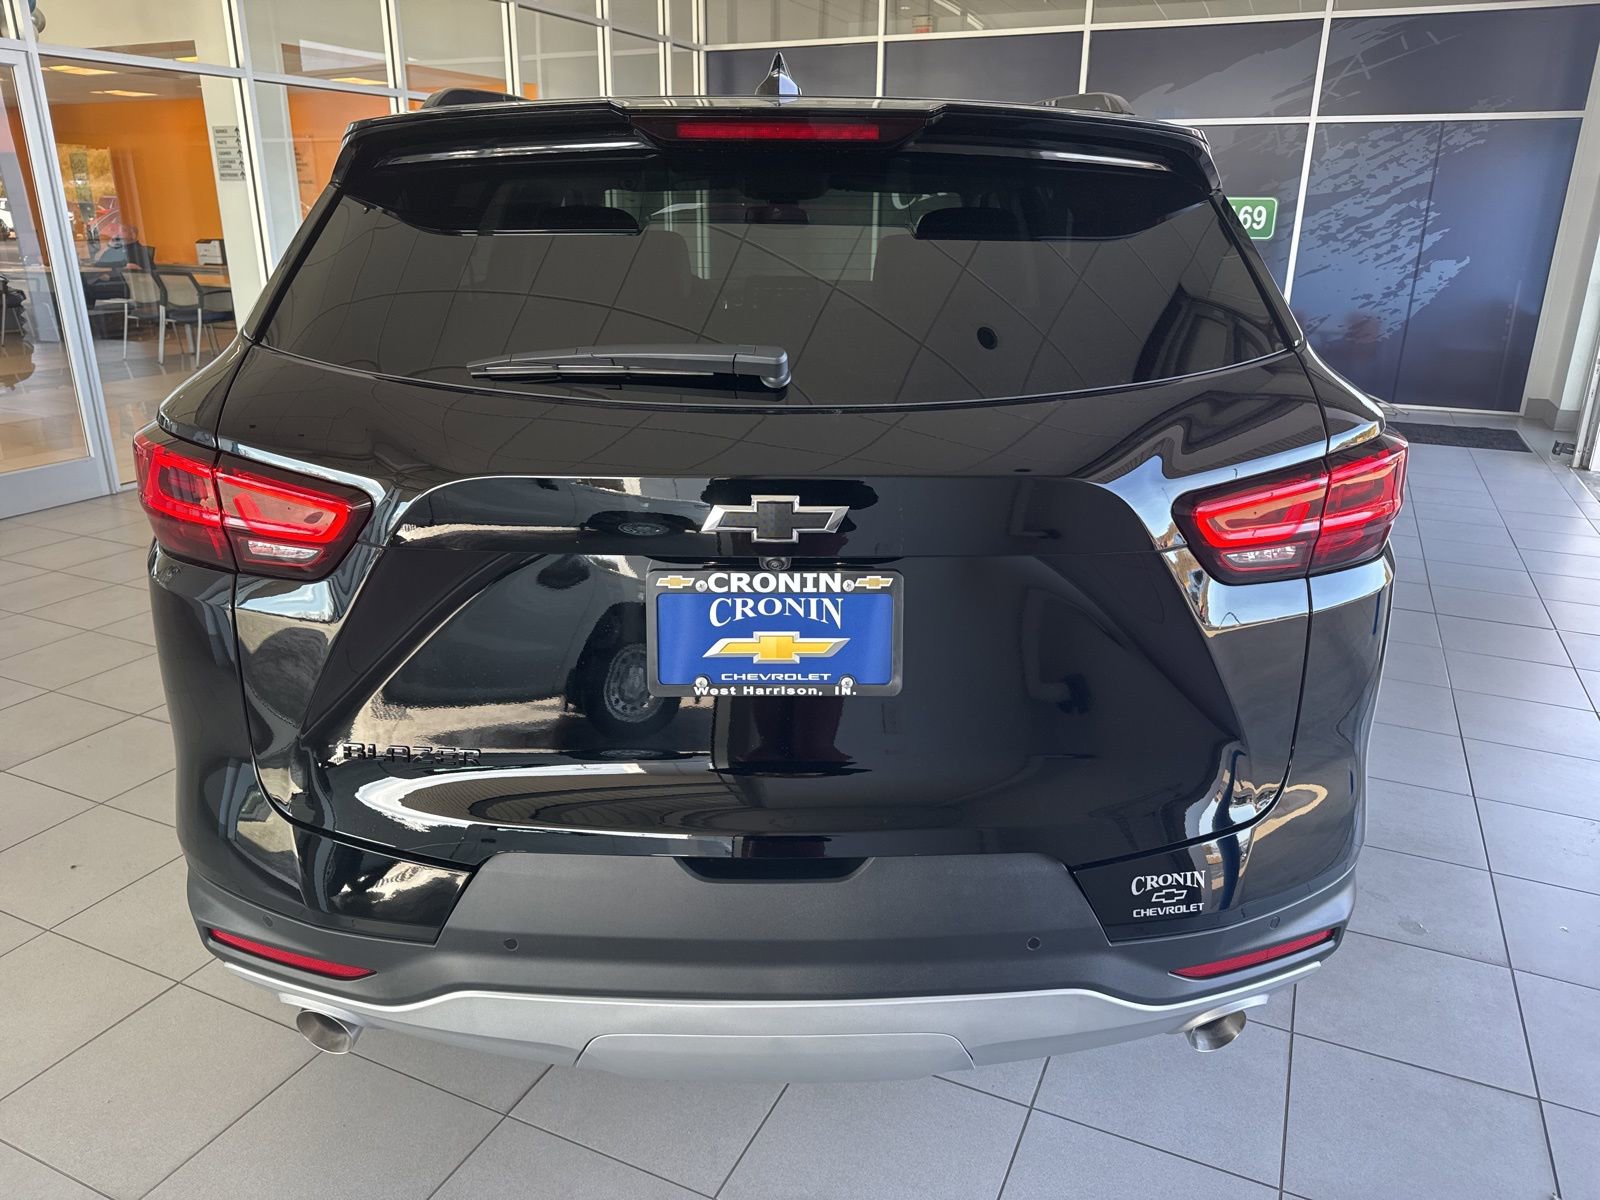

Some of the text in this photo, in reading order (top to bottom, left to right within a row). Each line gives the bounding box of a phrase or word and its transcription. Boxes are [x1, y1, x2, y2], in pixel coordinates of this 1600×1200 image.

[1232, 205, 1267, 230] 69
[707, 572, 842, 593] CRONIN
[709, 597, 844, 629] CRONIN
[721, 673, 832, 681] CHEVROLET
[693, 686, 736, 696] West
[743, 685, 823, 696] Harrison,
[343, 743, 481, 766] BLAZER
[1131, 870, 1206, 896] CRONIN
[1133, 902, 1205, 918] CHEVROLET
